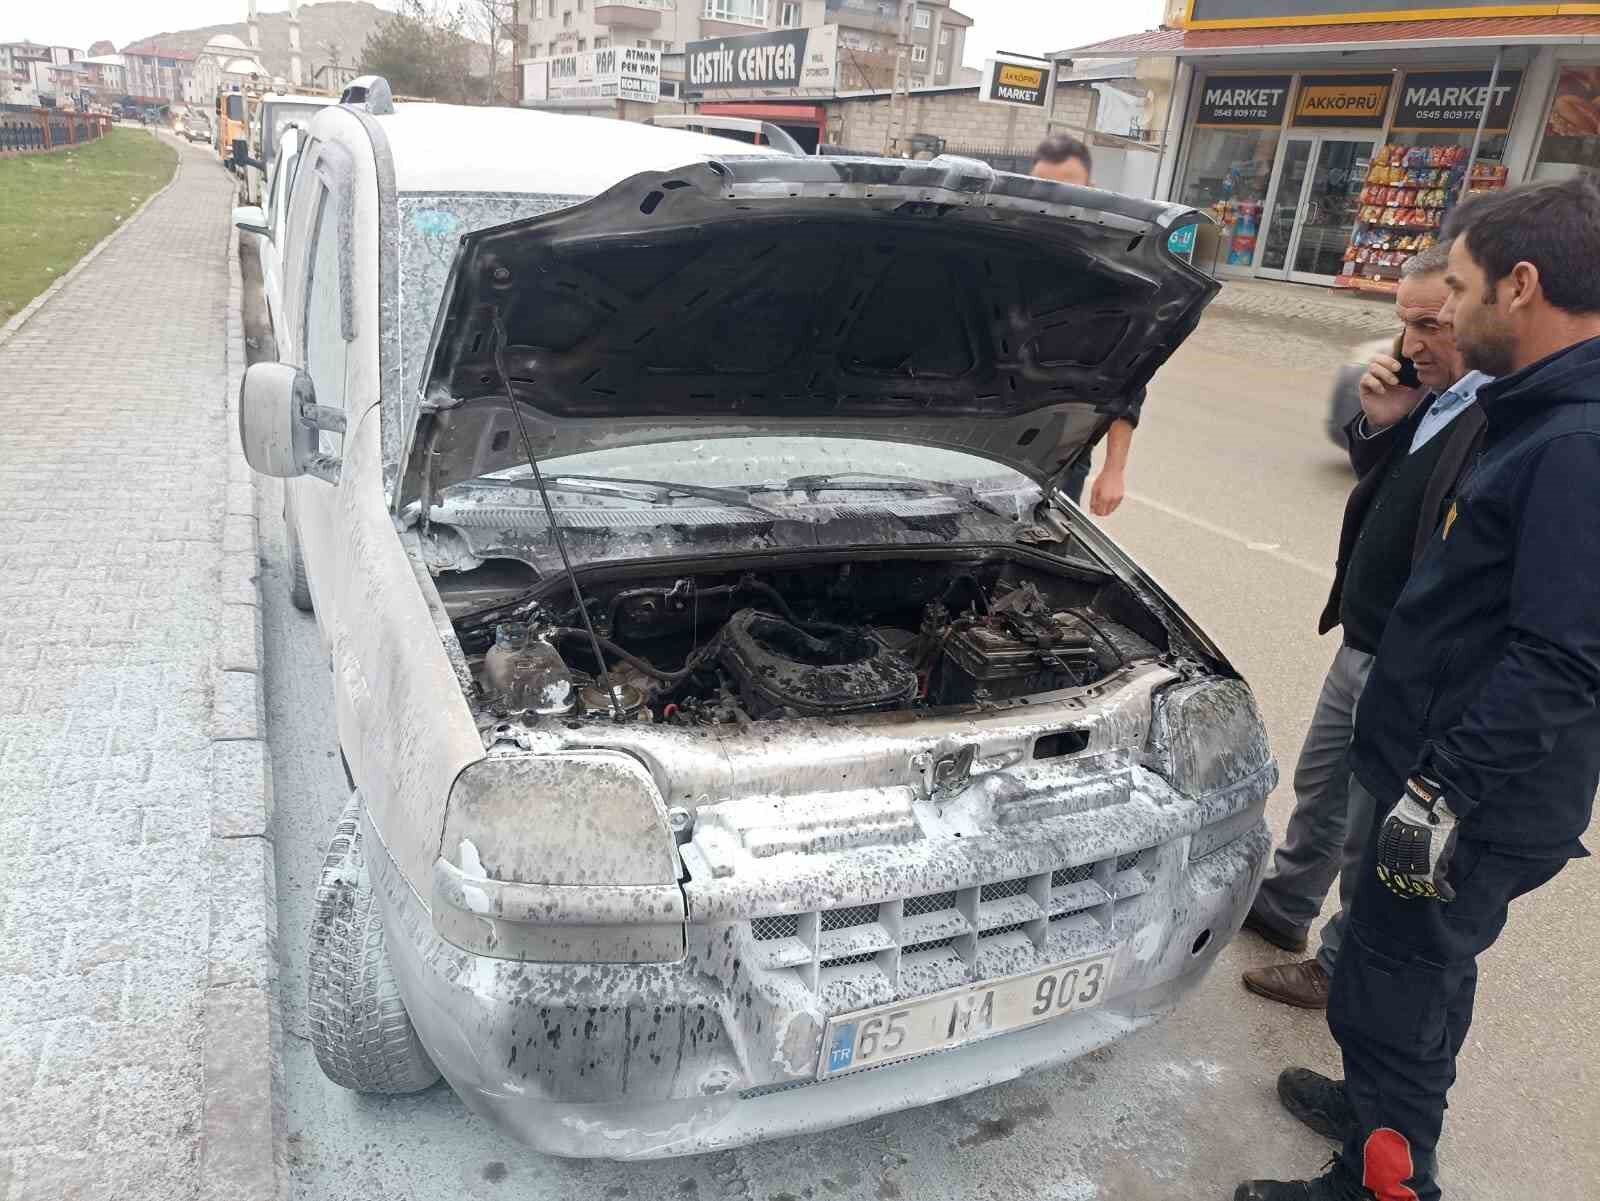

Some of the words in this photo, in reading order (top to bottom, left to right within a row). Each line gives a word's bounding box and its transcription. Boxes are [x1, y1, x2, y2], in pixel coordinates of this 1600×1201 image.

[625, 49, 656, 62] ATMAN
[690, 42, 734, 84] LASTİK
[737, 43, 796, 81] CENTER
[621, 61, 638, 73] PEN
[998, 86, 1039, 102] MARKET
[1205, 89, 1283, 106] MARKET
[1306, 93, 1377, 110] AKKÖPRÜ
[1405, 86, 1512, 107] MARKET
[1416, 110, 1440, 119] 0545
[860, 1010, 910, 1059] 65
[1032, 963, 1104, 1016] 903
[832, 1047, 851, 1064] TR
